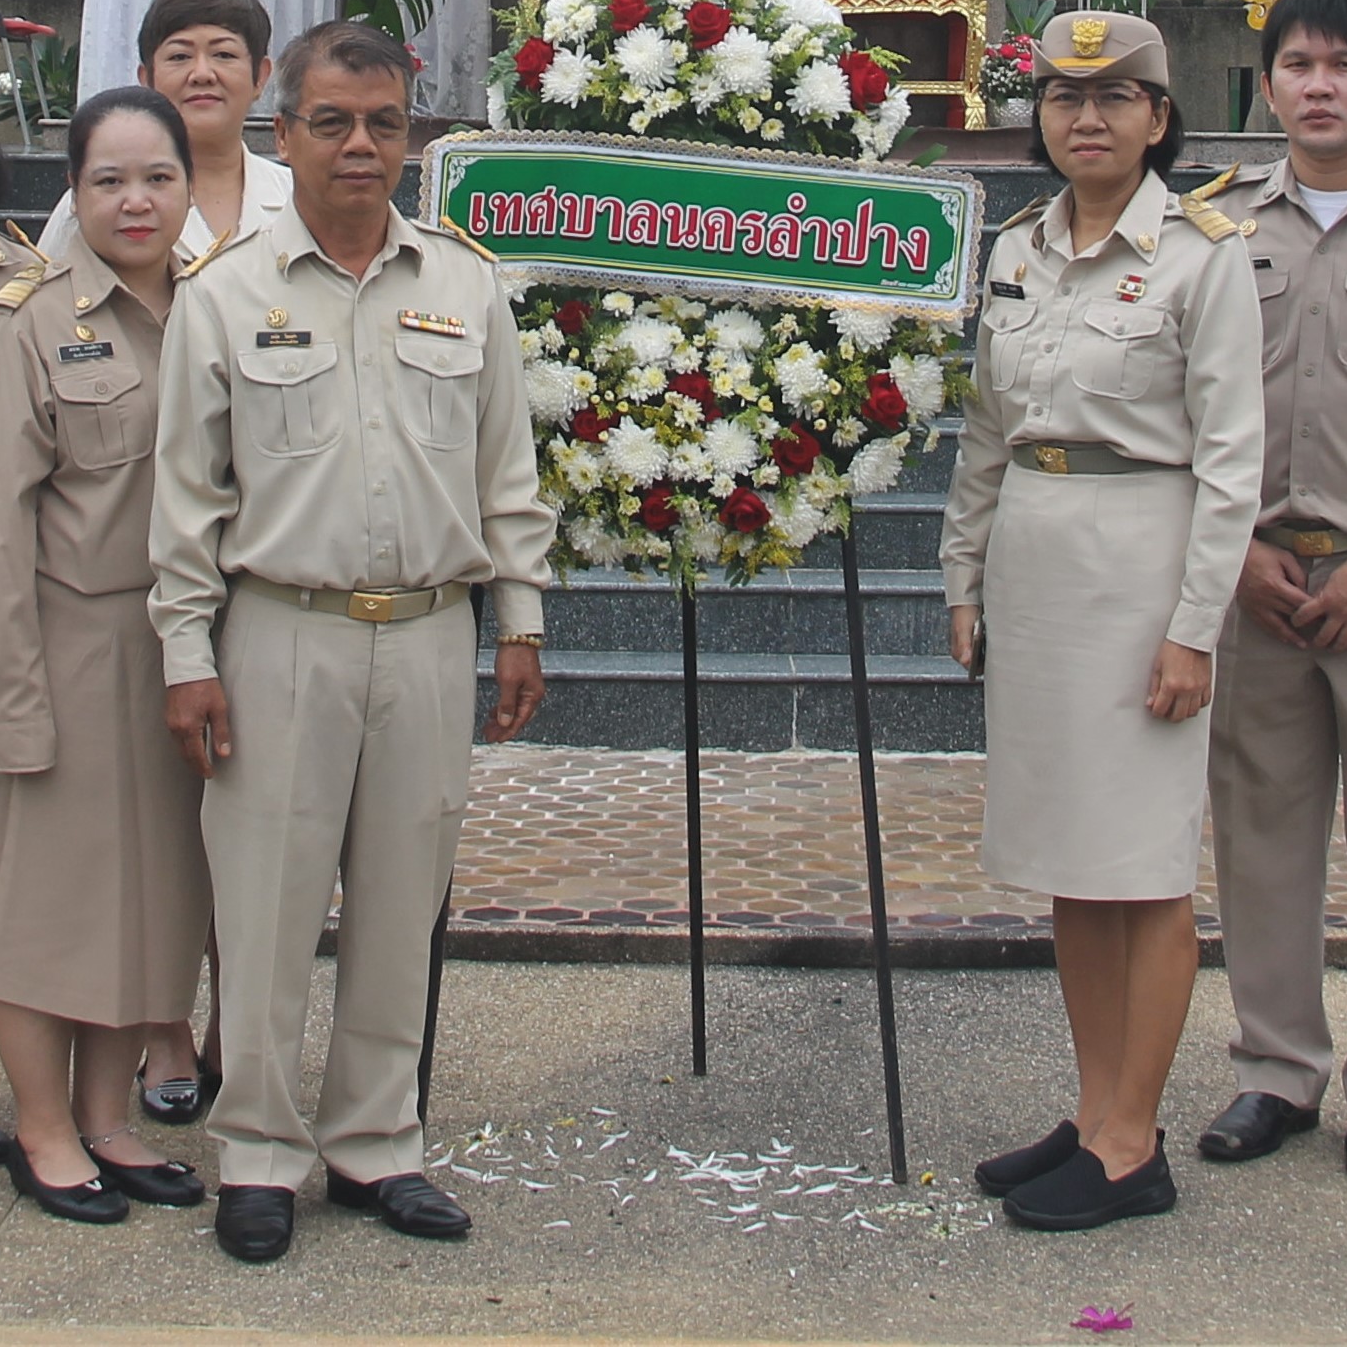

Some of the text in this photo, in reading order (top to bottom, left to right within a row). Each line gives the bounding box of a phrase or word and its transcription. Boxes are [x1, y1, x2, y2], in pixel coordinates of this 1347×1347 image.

[467, 185, 931, 273] เทศบาลนครลำปาง
